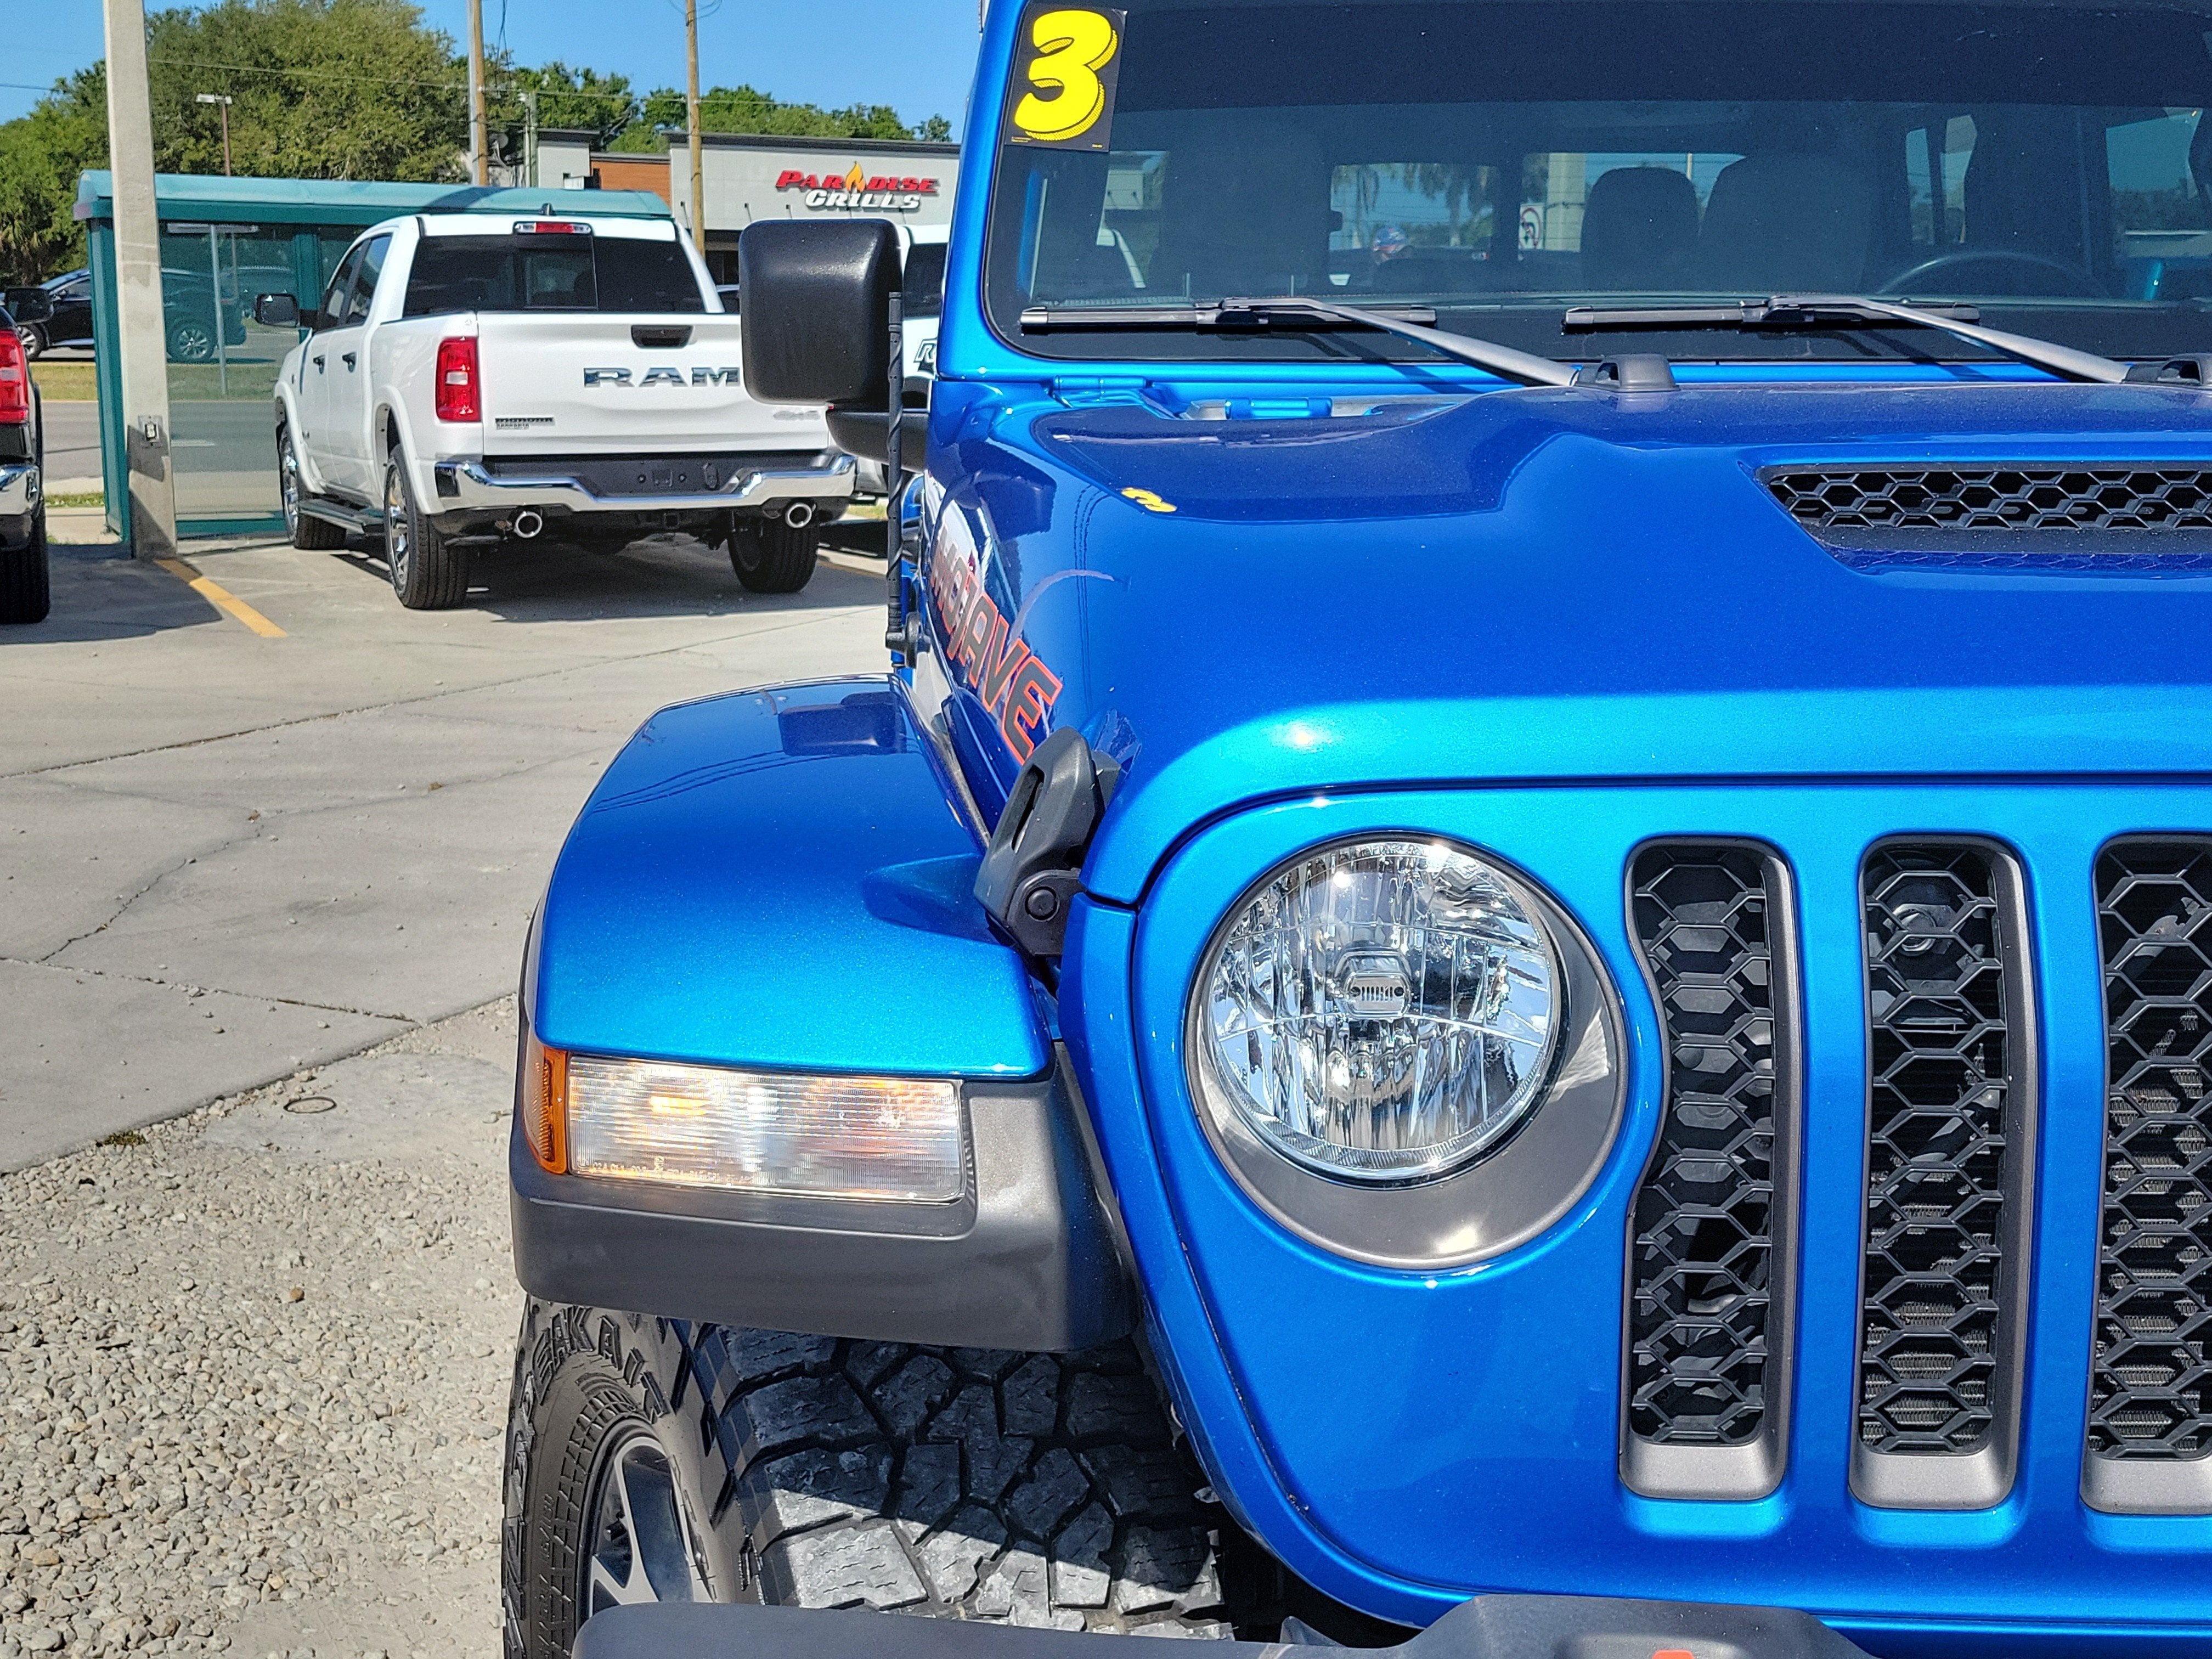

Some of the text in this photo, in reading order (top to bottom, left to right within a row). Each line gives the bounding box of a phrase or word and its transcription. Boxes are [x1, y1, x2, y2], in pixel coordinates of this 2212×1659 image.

[1014, 10, 1119, 141] 3
[776, 165, 939, 193] PARADISE
[805, 189, 921, 208] GRILLS
[584, 367, 741, 387] RAM
[931, 522, 1063, 766] MOJAVE
